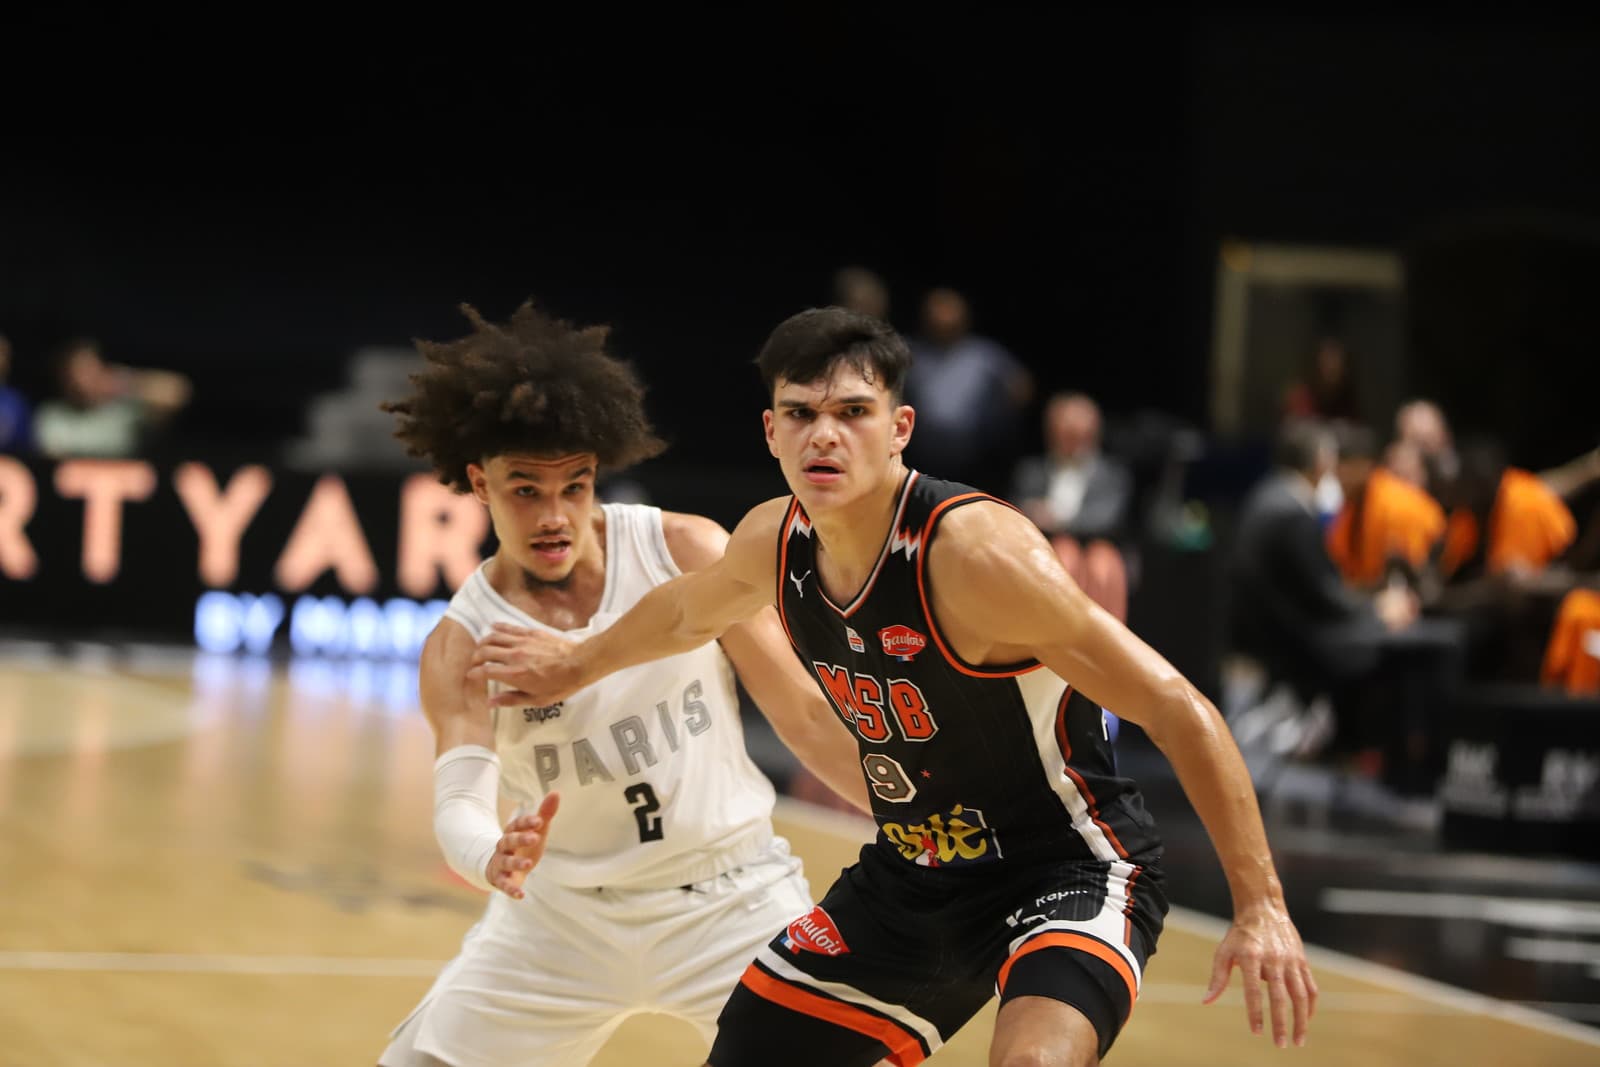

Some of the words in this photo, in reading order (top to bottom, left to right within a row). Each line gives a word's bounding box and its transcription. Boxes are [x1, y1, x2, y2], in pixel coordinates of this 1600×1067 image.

[882, 631, 925, 650] Gaulois
[813, 661, 939, 743] MSB
[534, 679, 712, 793] PARIS
[863, 753, 917, 803] 9
[624, 781, 664, 843] 2
[792, 915, 841, 954] aulois
